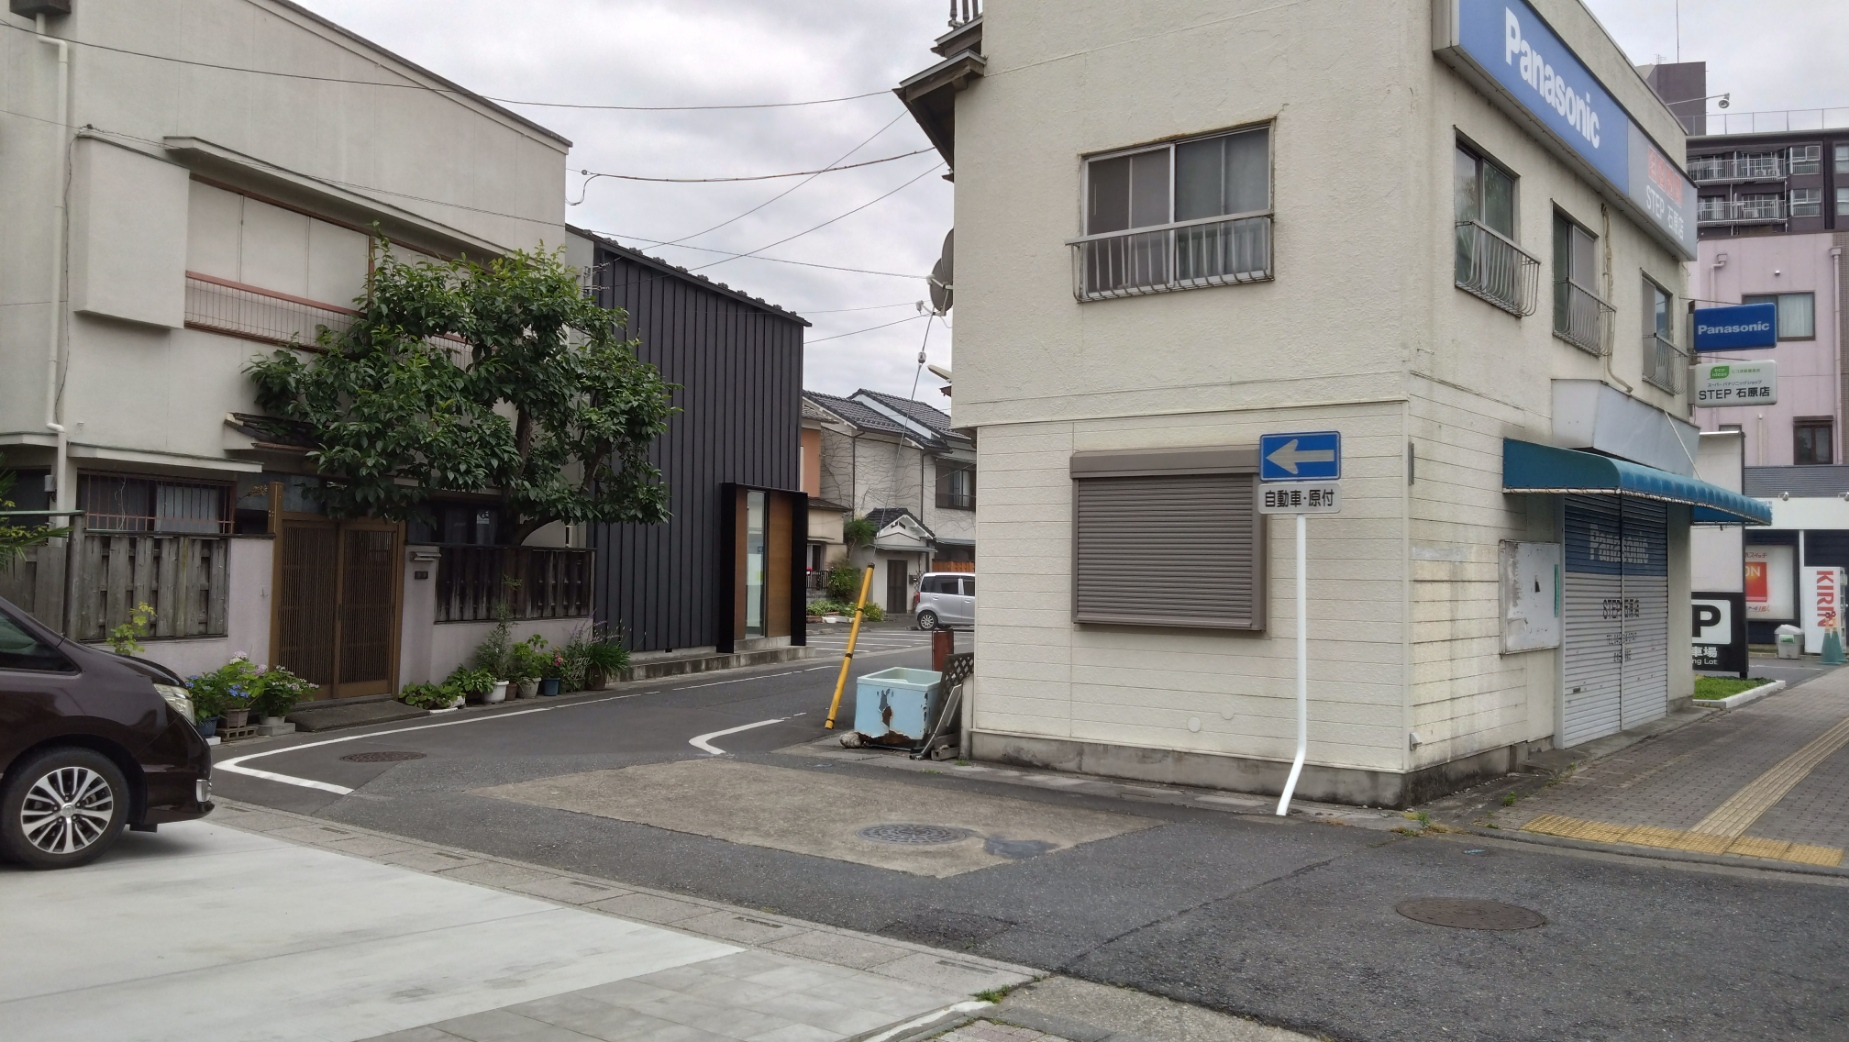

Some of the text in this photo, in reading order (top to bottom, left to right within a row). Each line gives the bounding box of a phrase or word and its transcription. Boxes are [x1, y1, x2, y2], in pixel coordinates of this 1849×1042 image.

[1505, 6, 1600, 149] Panasonic
[1646, 184, 1665, 220] STEP
[1667, 204, 1684, 241] 石原店
[1697, 321, 1770, 335] Panasonic
[1698, 386, 1770, 400] STEP 石原店
[1265, 488, 1335, 508] 自動車・原付
[1589, 523, 1649, 564] Panasonic
[1603, 599, 1622, 619] STEP
[1816, 570, 1834, 627] KIRIN
[1691, 604, 1721, 638] P
[1692, 646, 1718, 658] 車場
